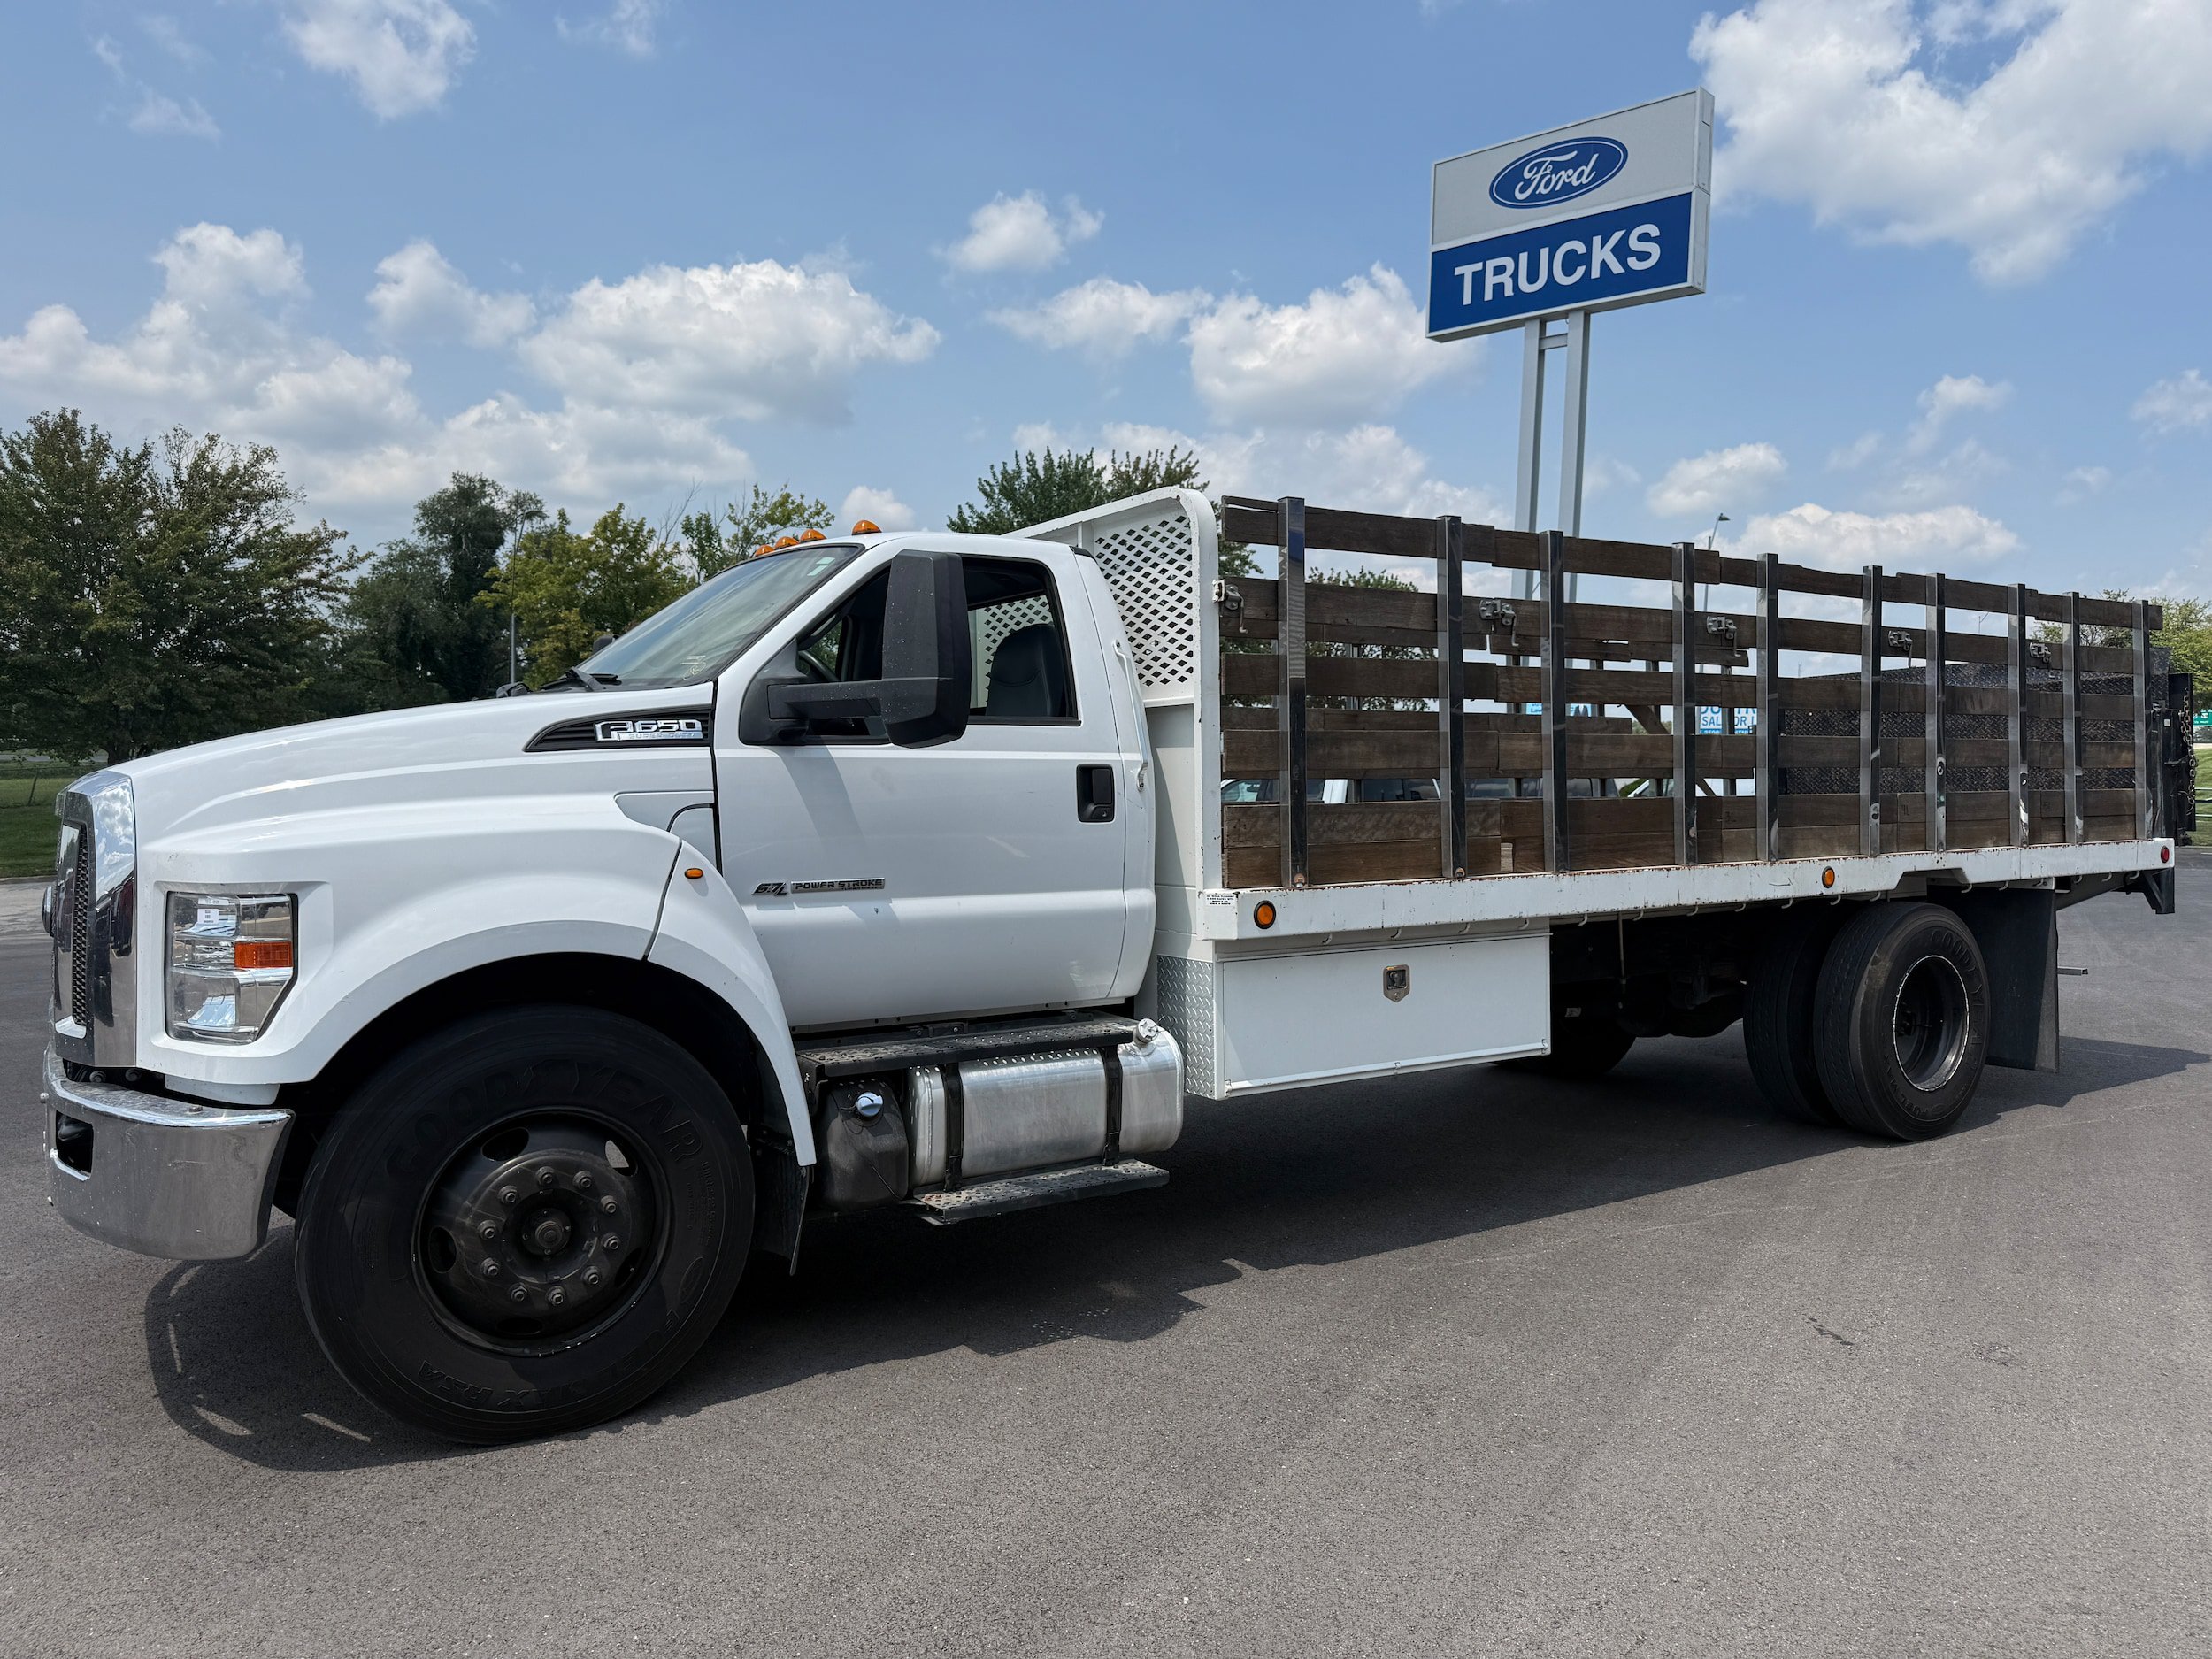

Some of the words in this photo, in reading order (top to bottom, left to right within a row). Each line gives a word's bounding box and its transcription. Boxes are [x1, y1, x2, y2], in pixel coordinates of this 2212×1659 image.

[1513, 150, 1599, 201] Ford
[1454, 223, 1662, 306] TRUCKS
[1701, 716, 1722, 726] SAL
[838, 879, 883, 888] STROKE
[383, 1059, 705, 1179] GOODYEAR
[417, 1359, 493, 1405] RSA
